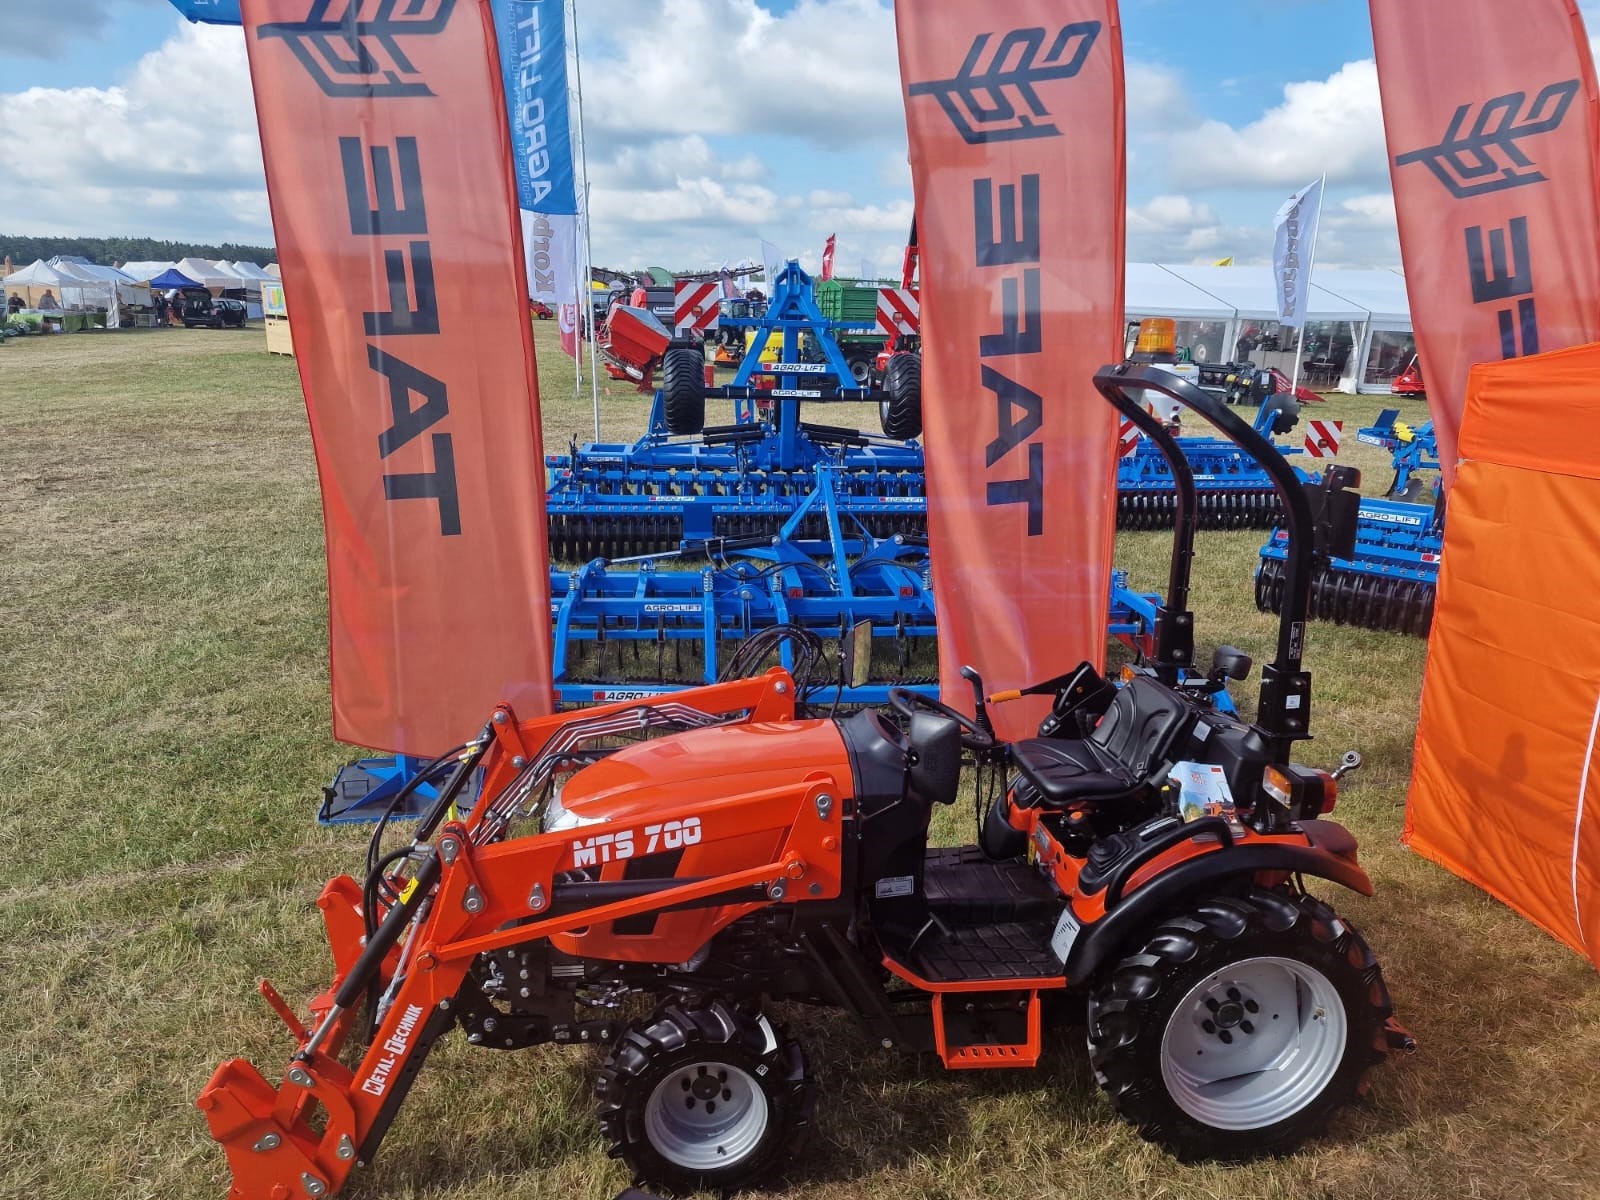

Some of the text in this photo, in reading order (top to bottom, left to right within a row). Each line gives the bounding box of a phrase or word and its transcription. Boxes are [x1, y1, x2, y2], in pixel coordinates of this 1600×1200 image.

[772, 364, 825, 372] AGRO-LIFT
[1358, 511, 1420, 525] AGRO-LIFT
[573, 816, 702, 868] MTS 700
[361, 1003, 424, 1096] METAL-TECHNIK
